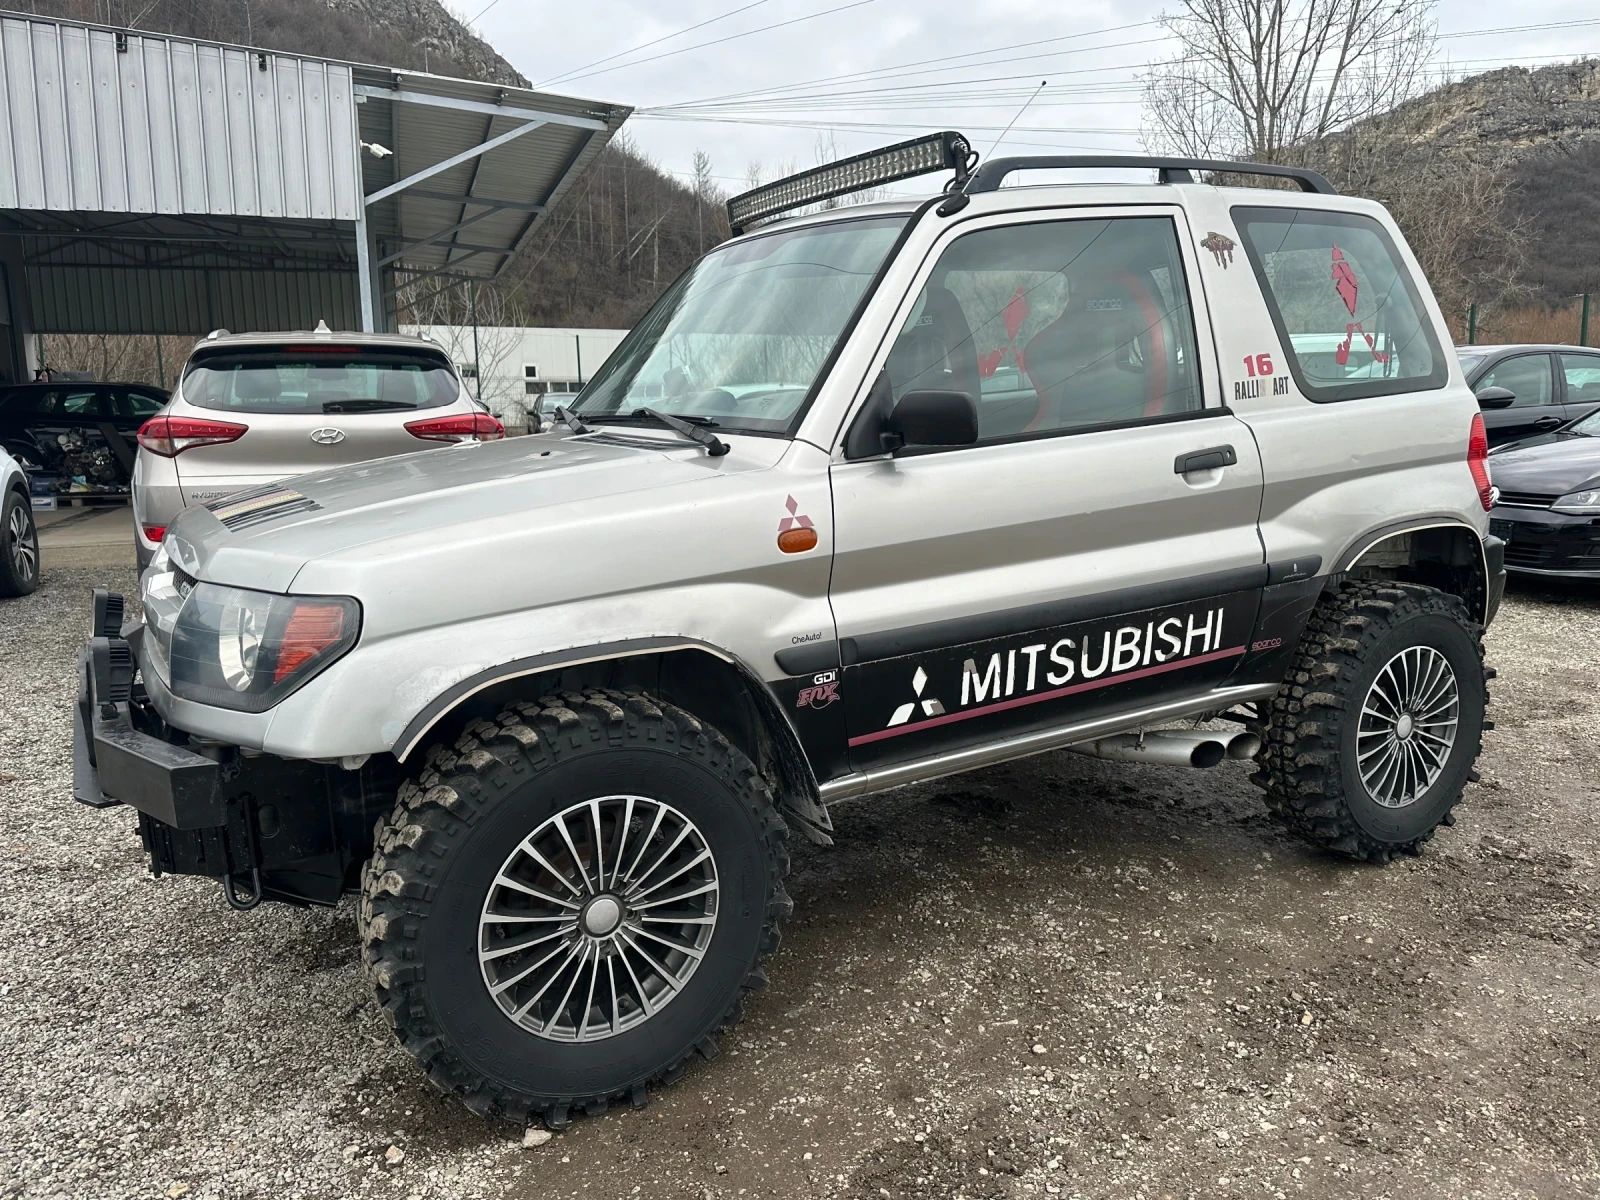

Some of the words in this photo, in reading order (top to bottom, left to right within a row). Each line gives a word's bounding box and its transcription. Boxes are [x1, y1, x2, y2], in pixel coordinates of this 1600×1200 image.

[1243, 353, 1274, 377] 16
[1234, 379, 1260, 401] RALLI
[1273, 376, 1289, 396] ART
[791, 632, 823, 645] CheAuto!
[1251, 637, 1282, 651] sparco
[960, 607, 1224, 706] MITSUBISHI
[814, 670, 837, 685] GDI
[797, 681, 840, 709] FOX
